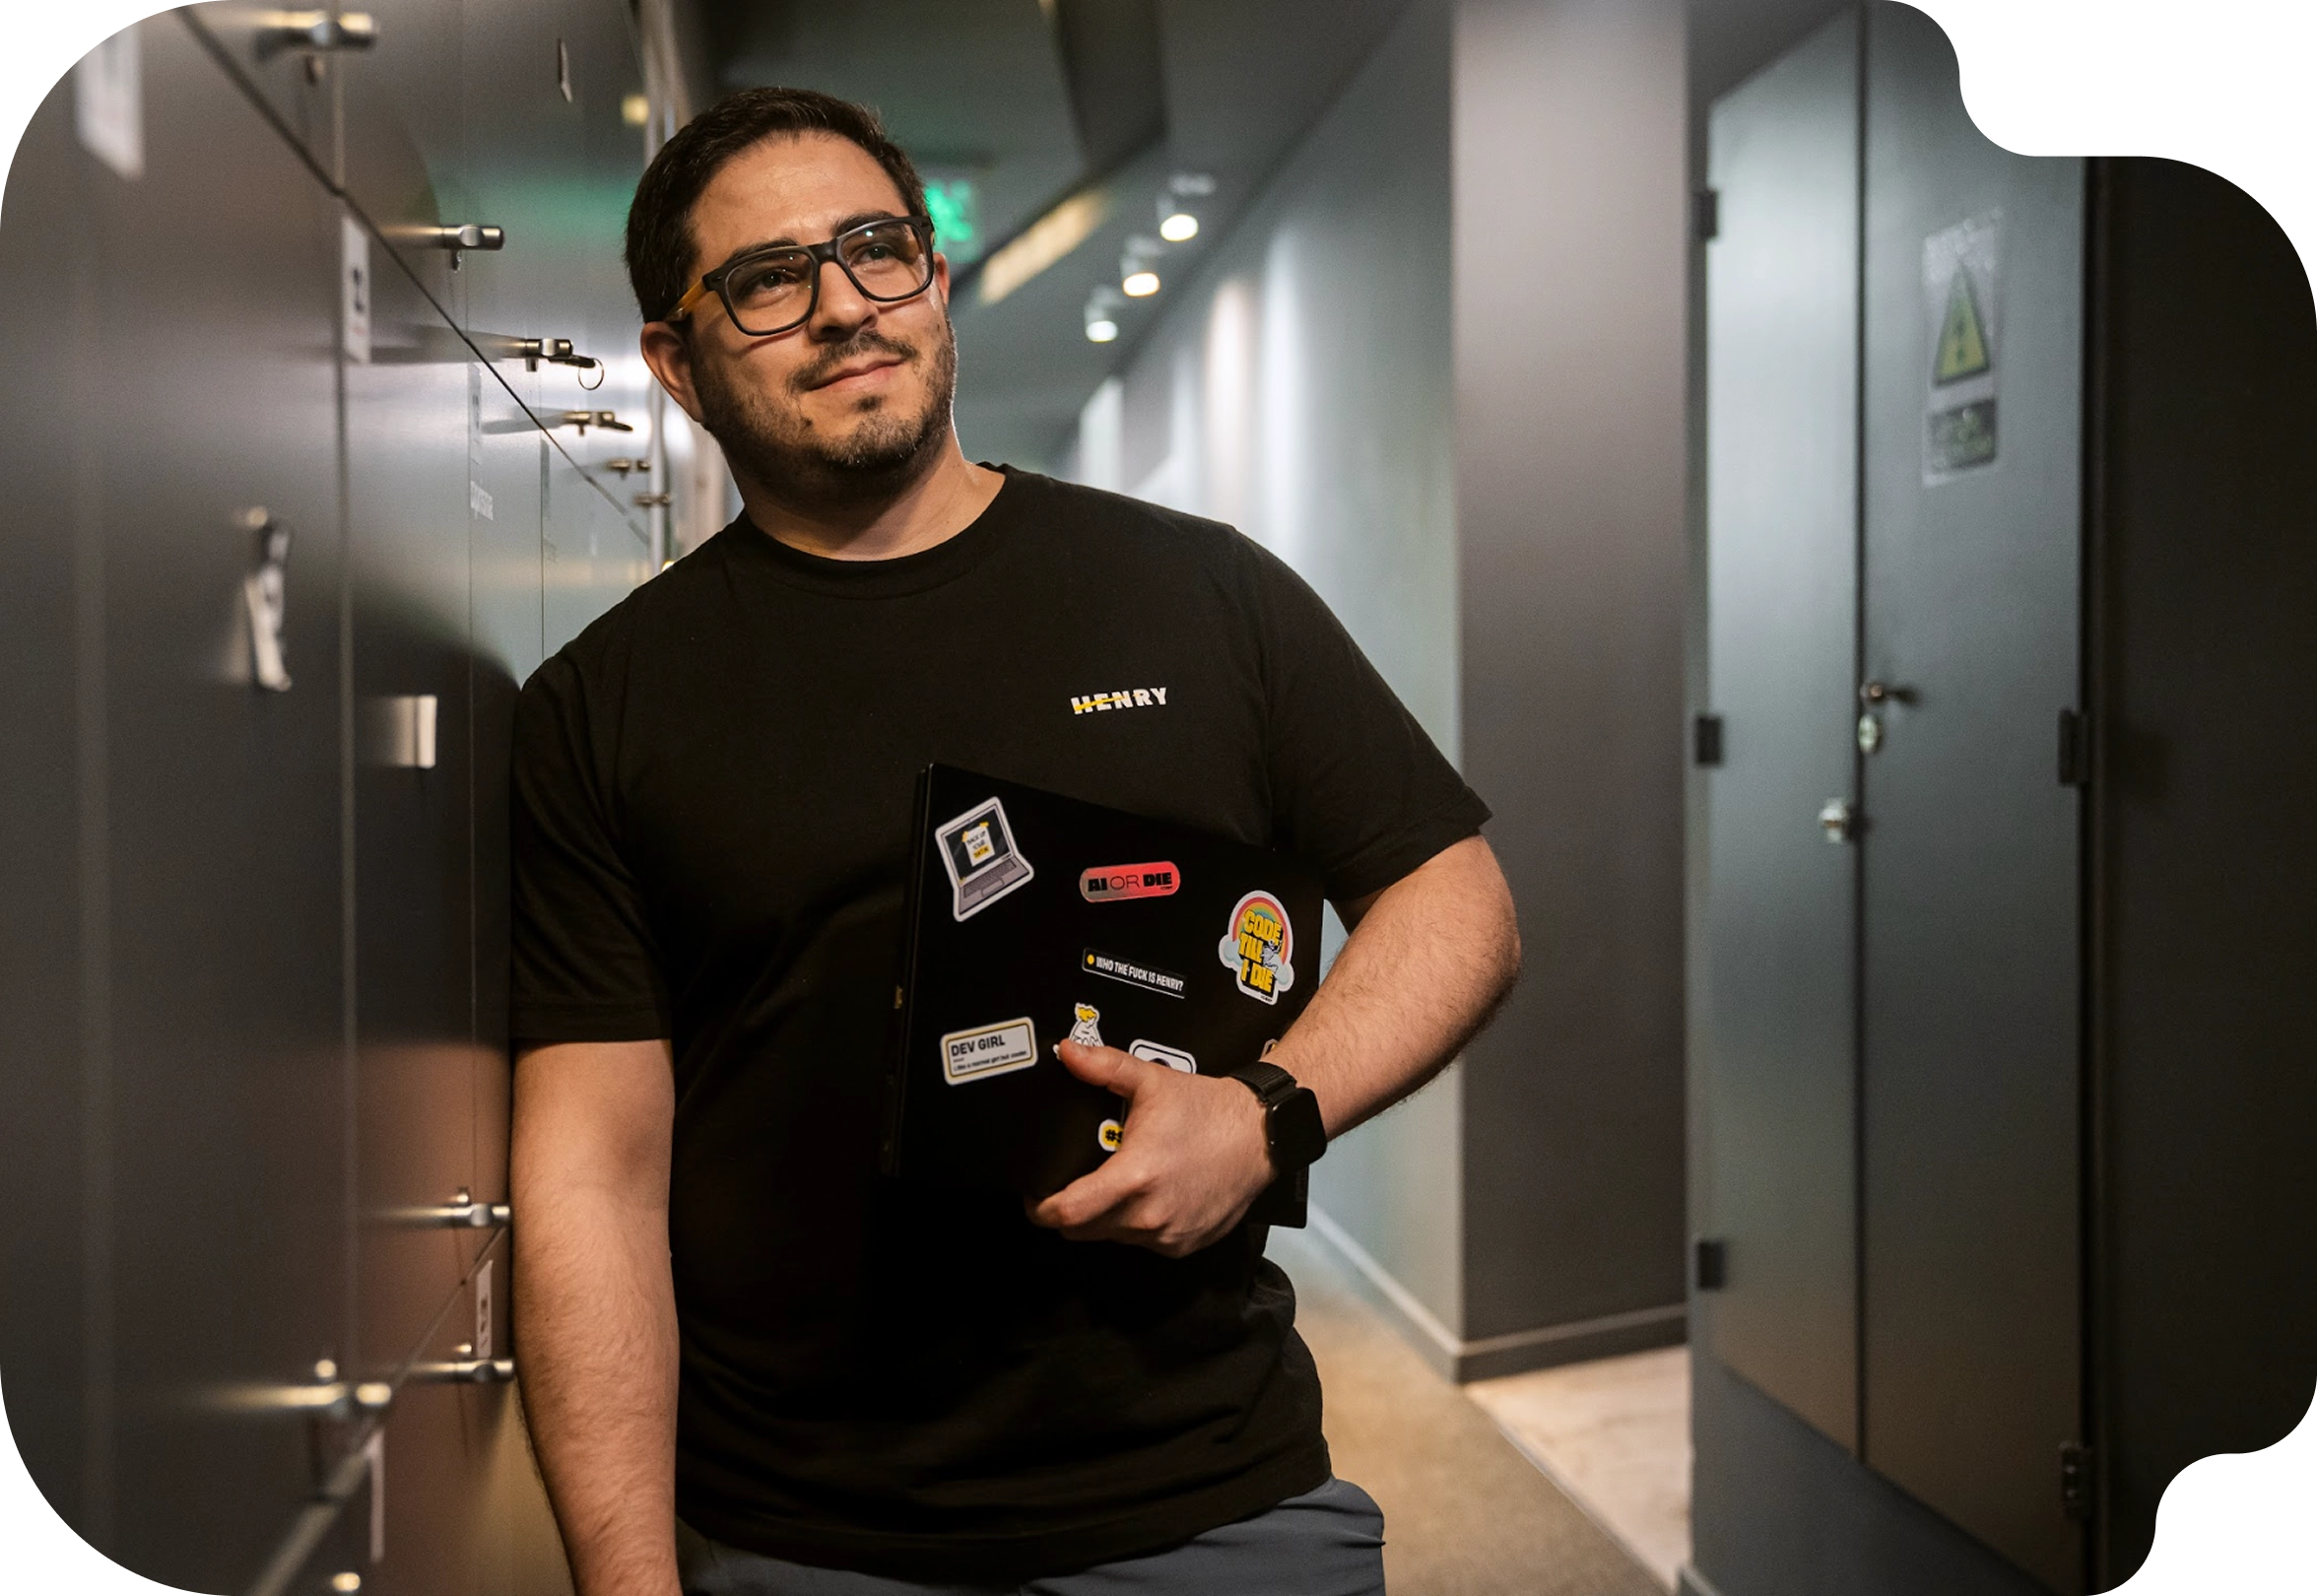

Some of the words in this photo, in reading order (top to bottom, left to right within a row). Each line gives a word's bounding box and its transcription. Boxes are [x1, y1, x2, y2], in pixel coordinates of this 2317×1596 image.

[1070, 687, 1166, 715] HENRY
[1088, 878, 1107, 892] AI
[1110, 875, 1140, 891] OR
[1143, 872, 1172, 887] DIE
[1243, 908, 1283, 947] CODE
[1238, 931, 1264, 964] TILL
[1095, 956, 1114, 972] WHO
[1114, 962, 1129, 976] THE
[1128, 965, 1148, 981] FUCK
[1148, 970, 1156, 983] IS
[1156, 973, 1184, 992] HENRY?
[1249, 962, 1274, 993] DIE
[951, 1040, 975, 1056] DEV
[978, 1034, 1005, 1050] GIRL
